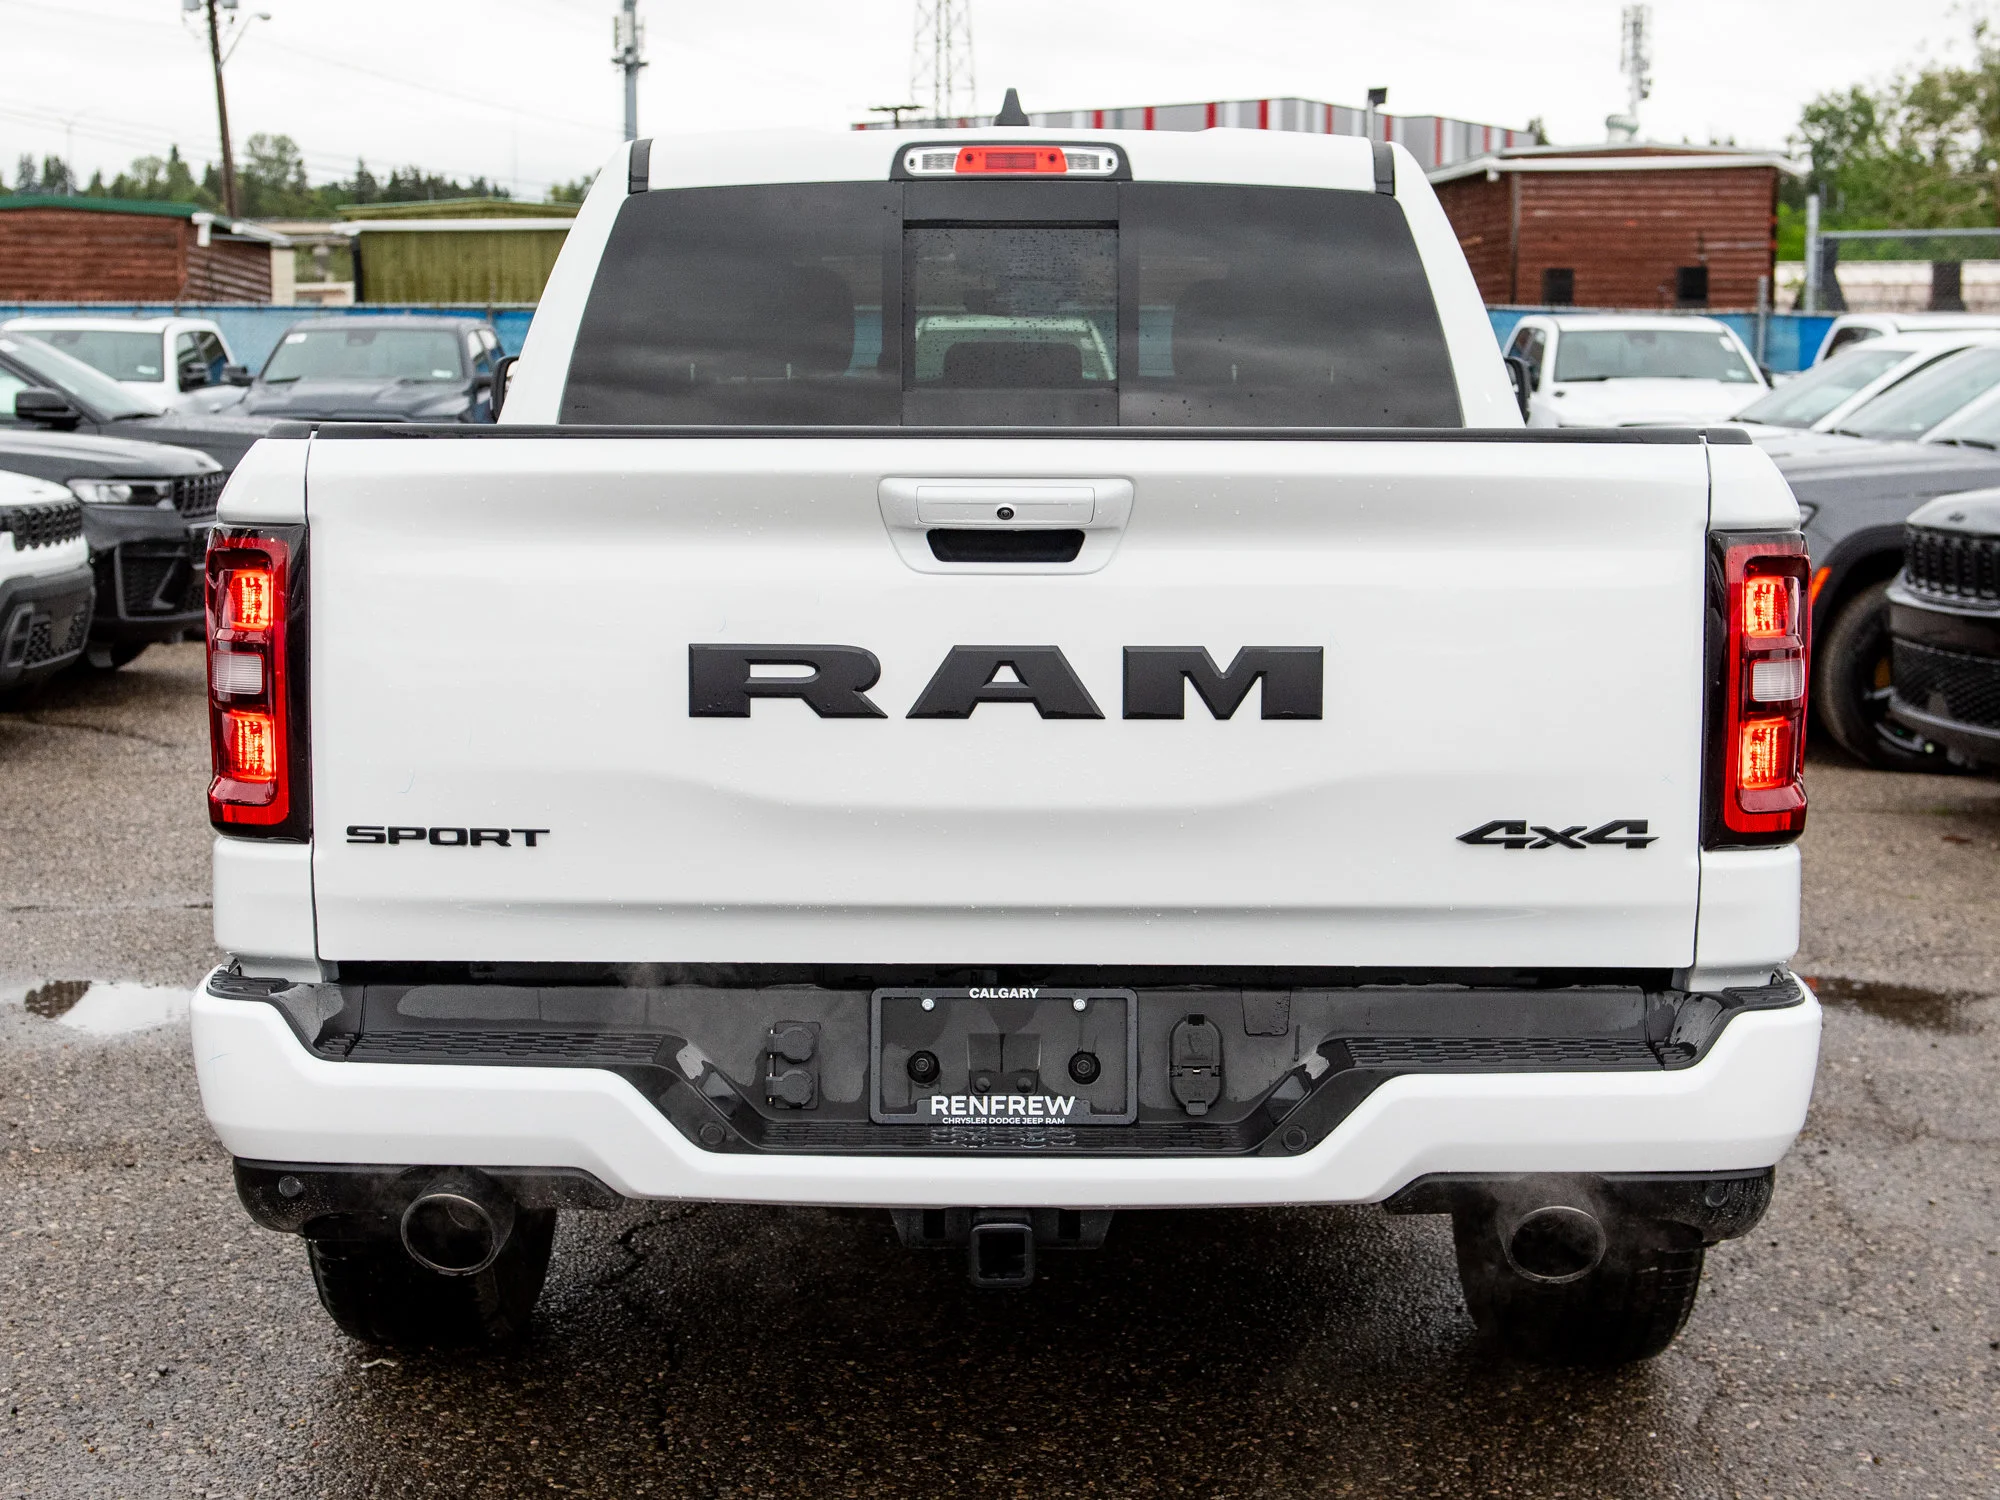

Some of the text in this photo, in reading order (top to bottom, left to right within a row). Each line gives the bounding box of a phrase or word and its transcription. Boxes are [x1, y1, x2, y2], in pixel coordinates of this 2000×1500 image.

[688, 643, 1324, 721] RAM
[346, 825, 551, 847] SPORT
[1455, 819, 1660, 849] 4x4
[968, 987, 1040, 999] CALGARY
[930, 1095, 1076, 1116] RENFREW
[942, 1117, 1066, 1125] CHRYSLER DODGE JEEP RAM
